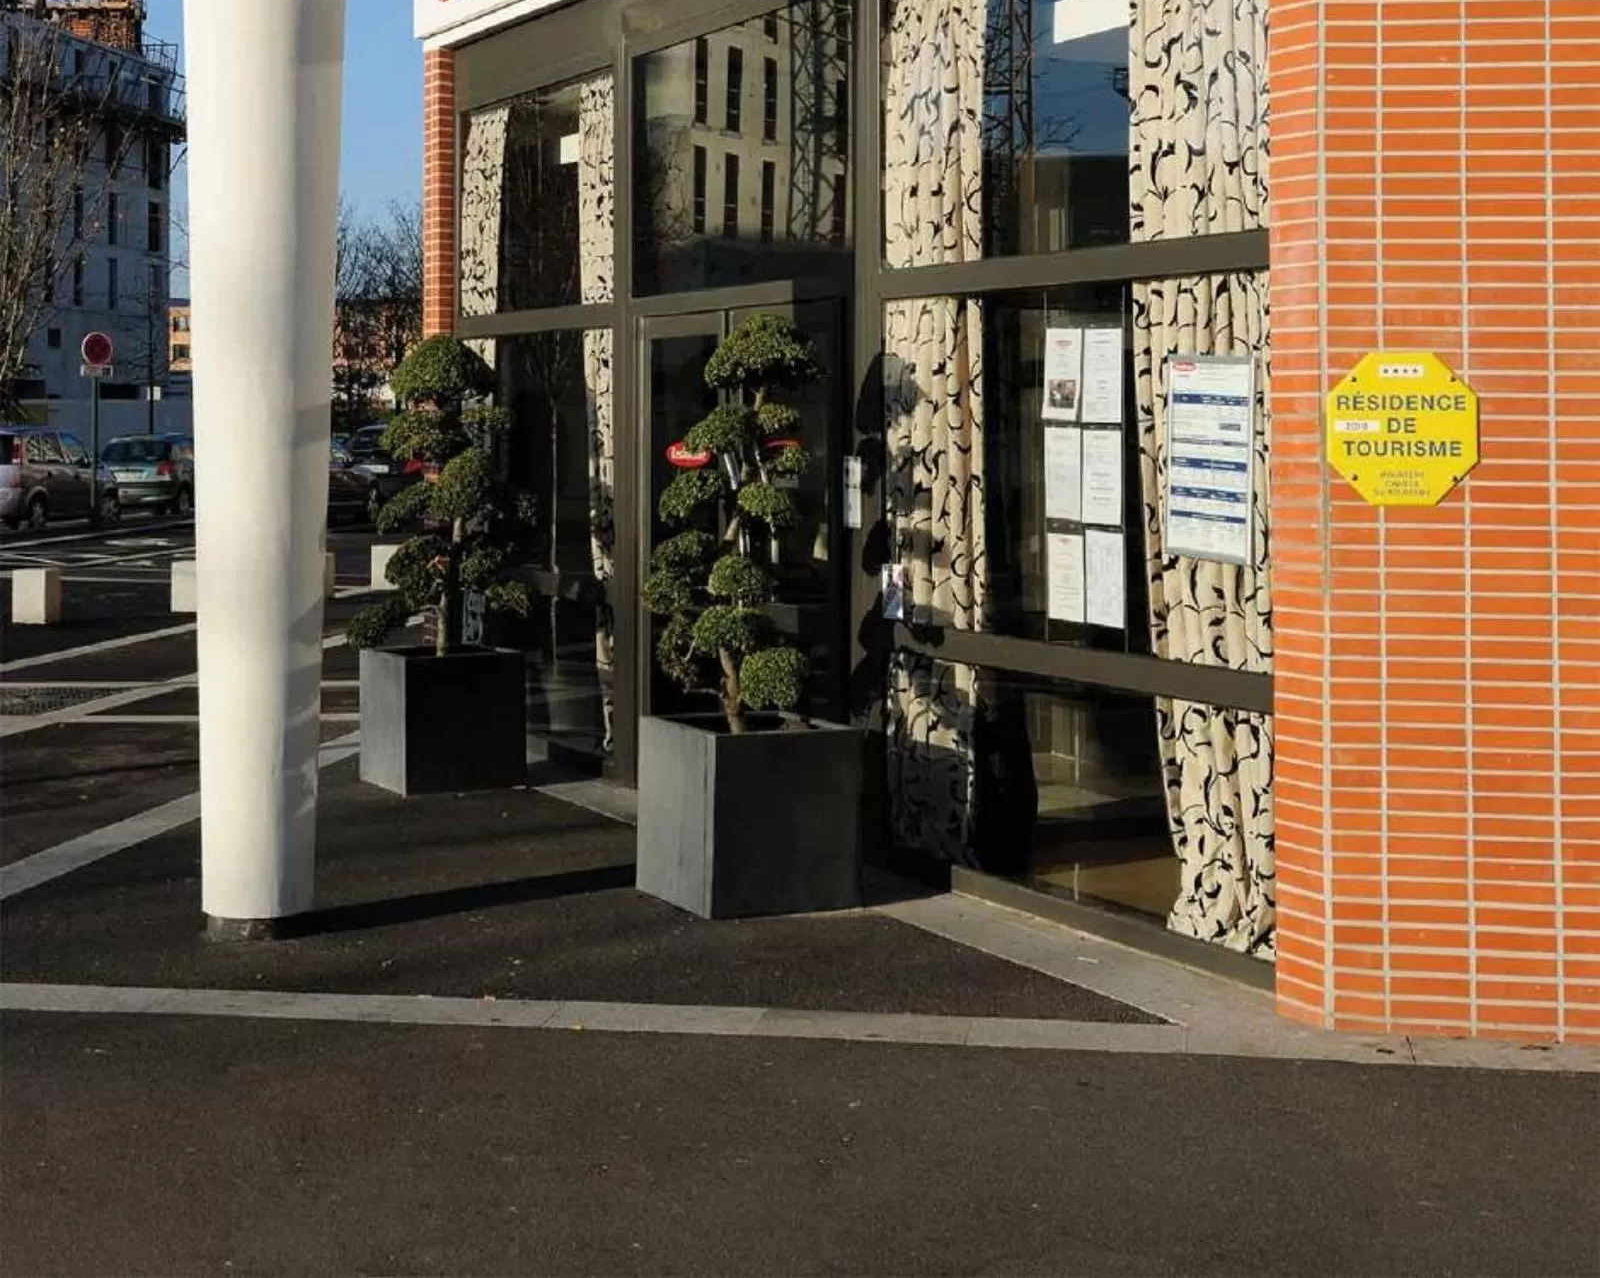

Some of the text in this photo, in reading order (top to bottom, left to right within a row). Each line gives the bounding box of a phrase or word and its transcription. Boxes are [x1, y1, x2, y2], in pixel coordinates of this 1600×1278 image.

[1336, 391, 1466, 411] RÉSIDENCE
[1387, 418, 1415, 433] DE
[1343, 440, 1462, 457] TOURISME
